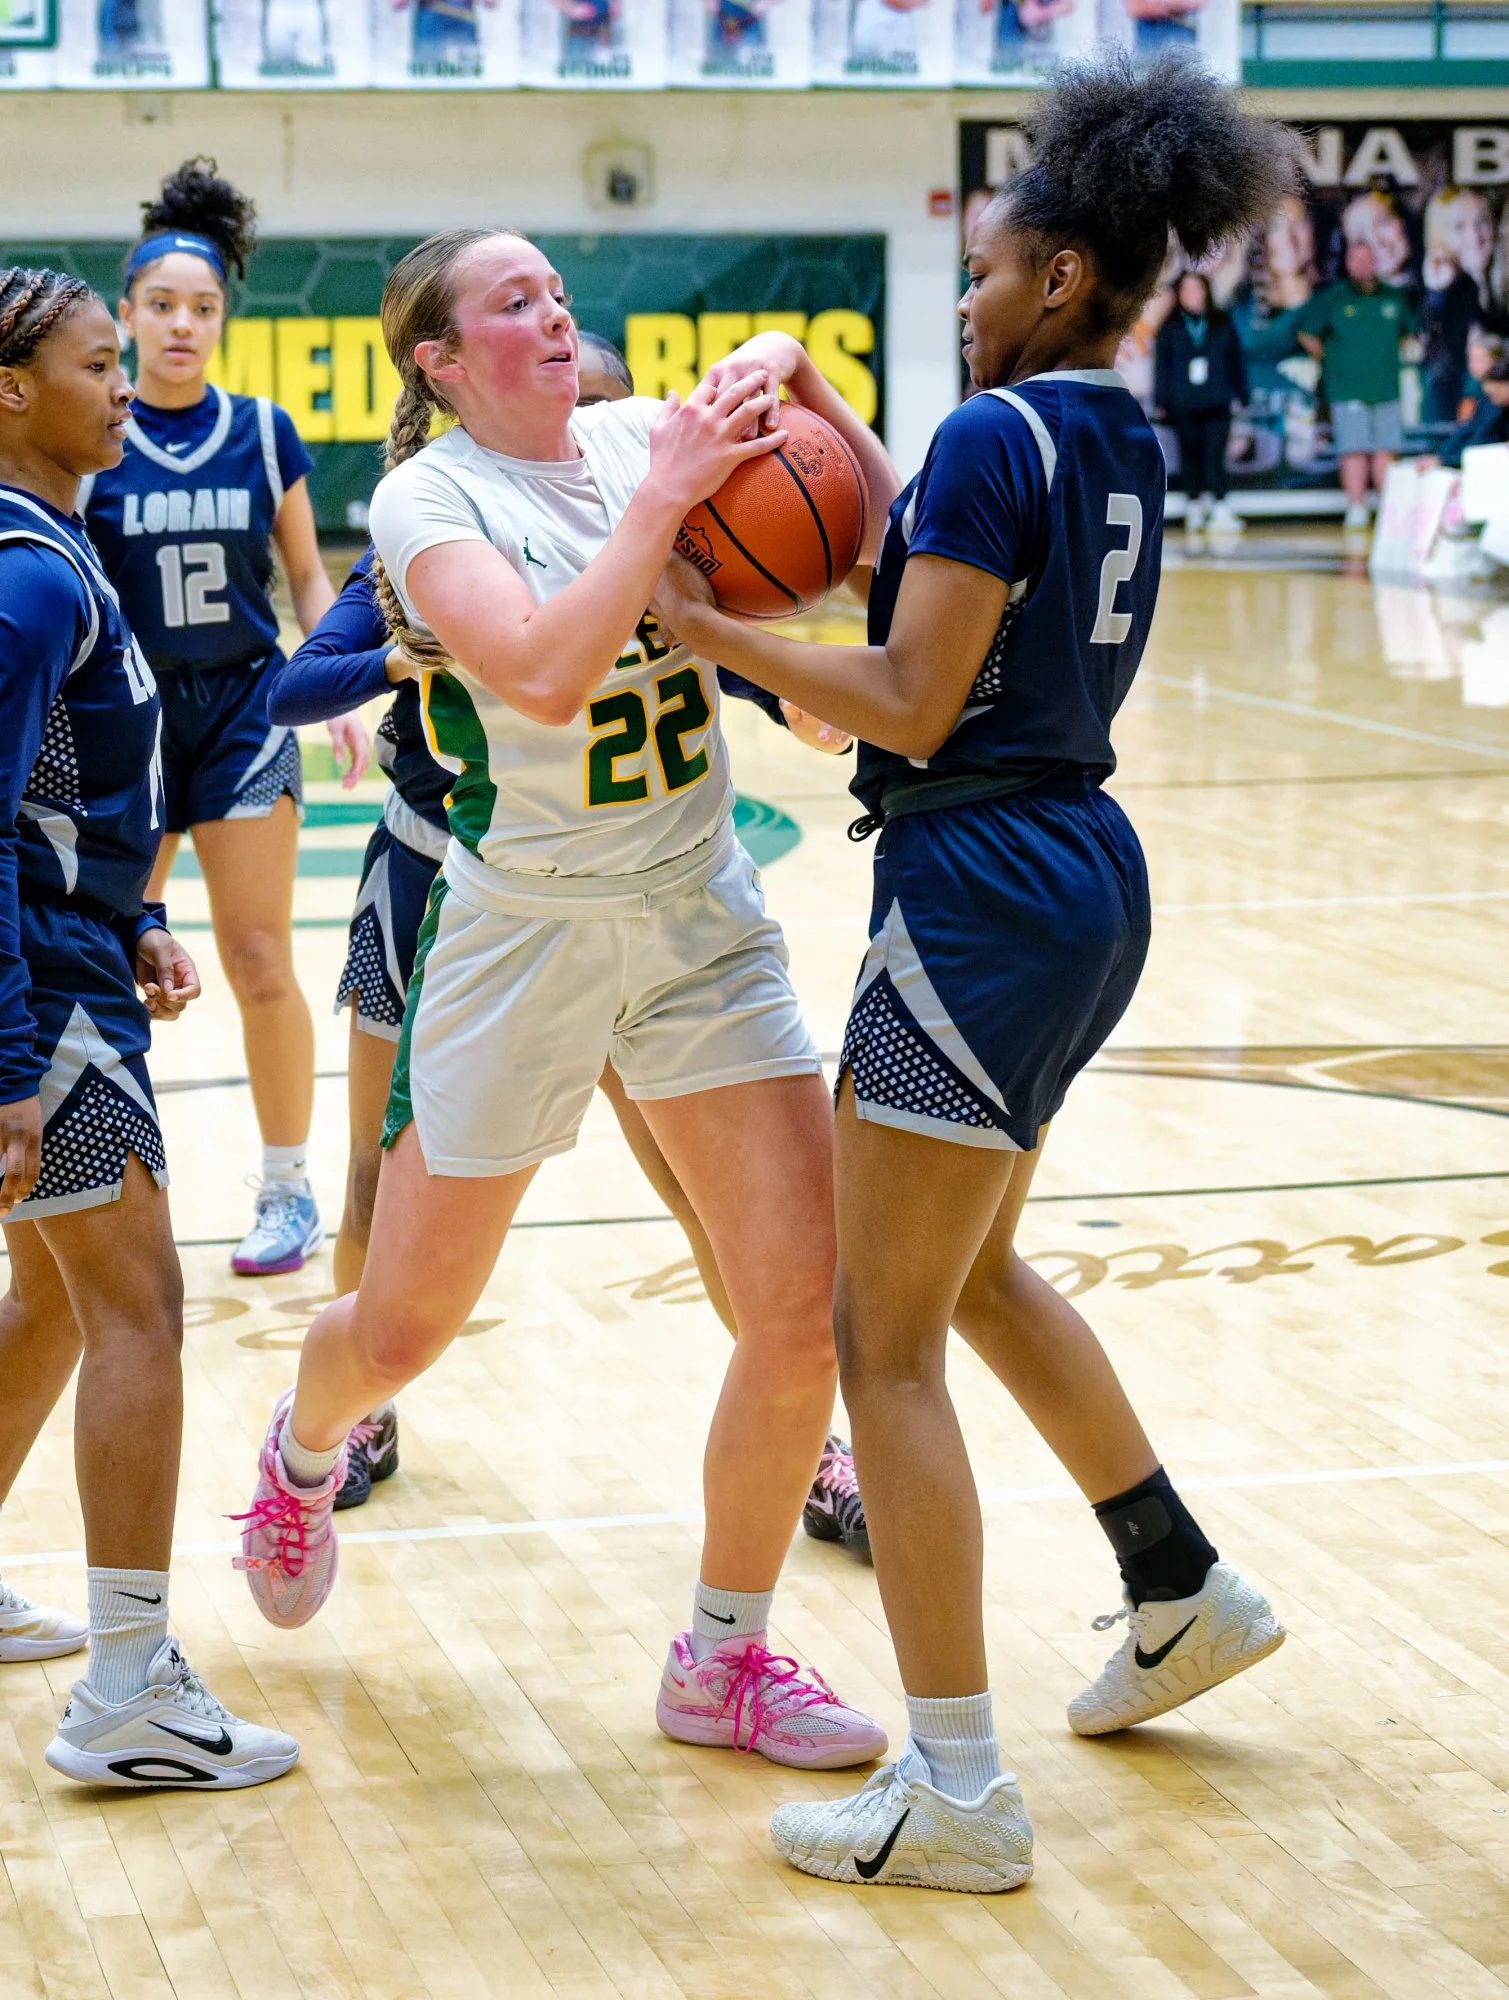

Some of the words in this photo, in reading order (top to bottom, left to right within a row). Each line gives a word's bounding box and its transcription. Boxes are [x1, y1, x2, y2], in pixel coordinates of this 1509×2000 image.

[204, 316, 425, 442] MED
[122, 487, 250, 536] LORAIN
[1089, 492, 1143, 645] 2
[156, 542, 230, 628] 12
[585, 662, 714, 809] 22
